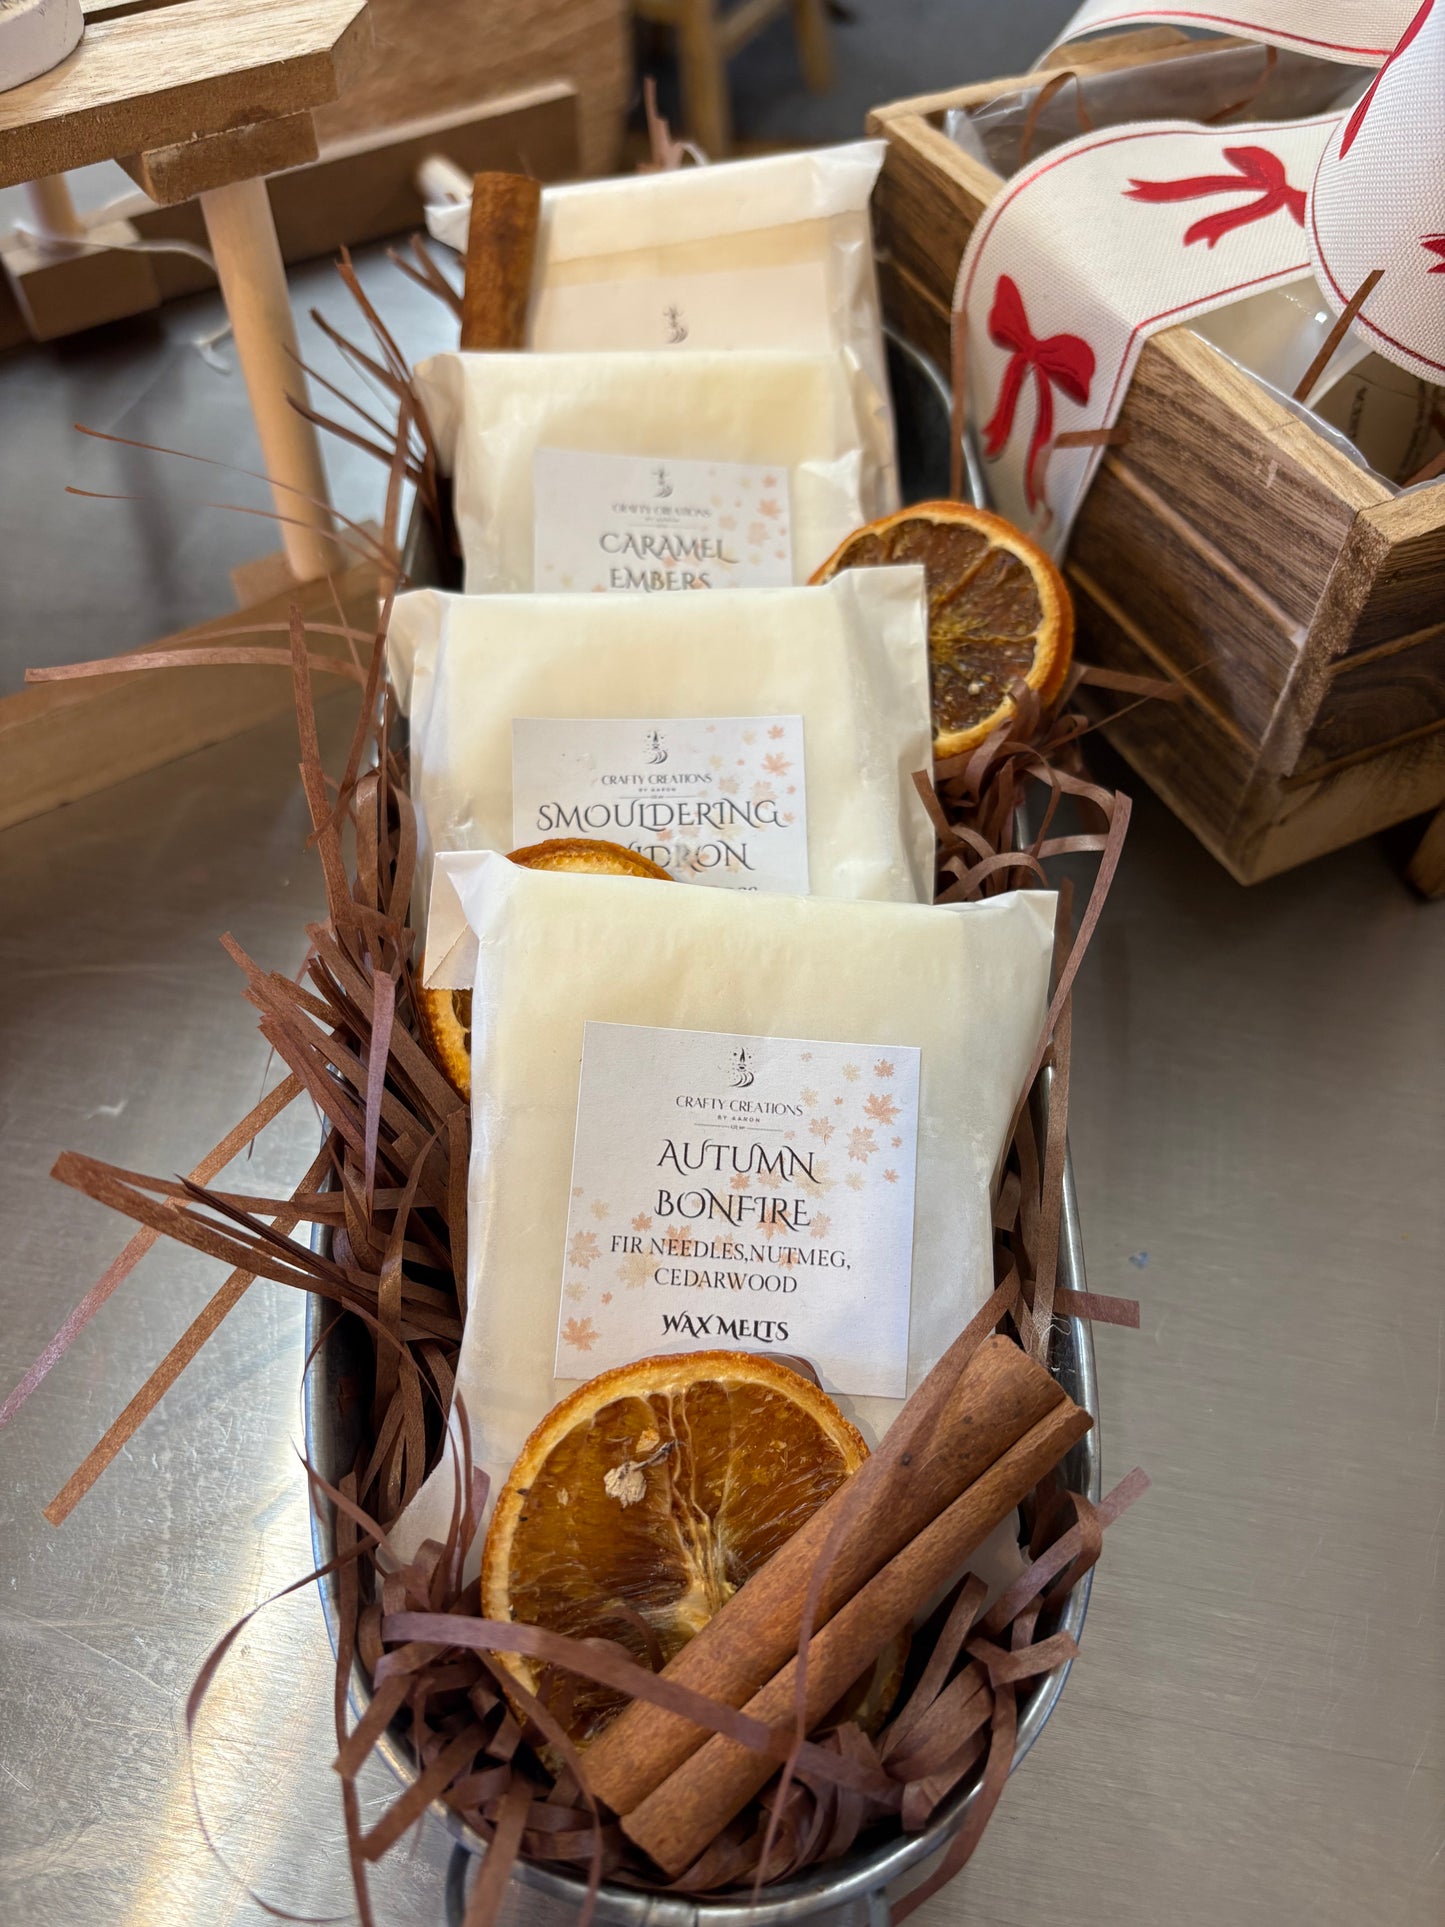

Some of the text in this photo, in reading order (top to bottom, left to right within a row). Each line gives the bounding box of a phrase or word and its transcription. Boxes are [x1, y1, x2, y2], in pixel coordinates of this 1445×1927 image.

[600, 532, 741, 564] CARAMEL
[610, 567, 713, 592] EMBERS
[601, 773, 713, 785] CRAFTY CREATIONS
[536, 798, 791, 833] SMOULDERING
[676, 1095, 804, 1117] CRAFTY CREATIONS
[732, 1115, 761, 1123] AARON
[657, 1138, 822, 1185] AUTUMN
[654, 1187, 812, 1231] BONFIRE
[611, 1235, 644, 1255] FIR
[654, 1267, 798, 1293] CEDARWOOD
[661, 1310, 790, 1343] WAX MELTS
